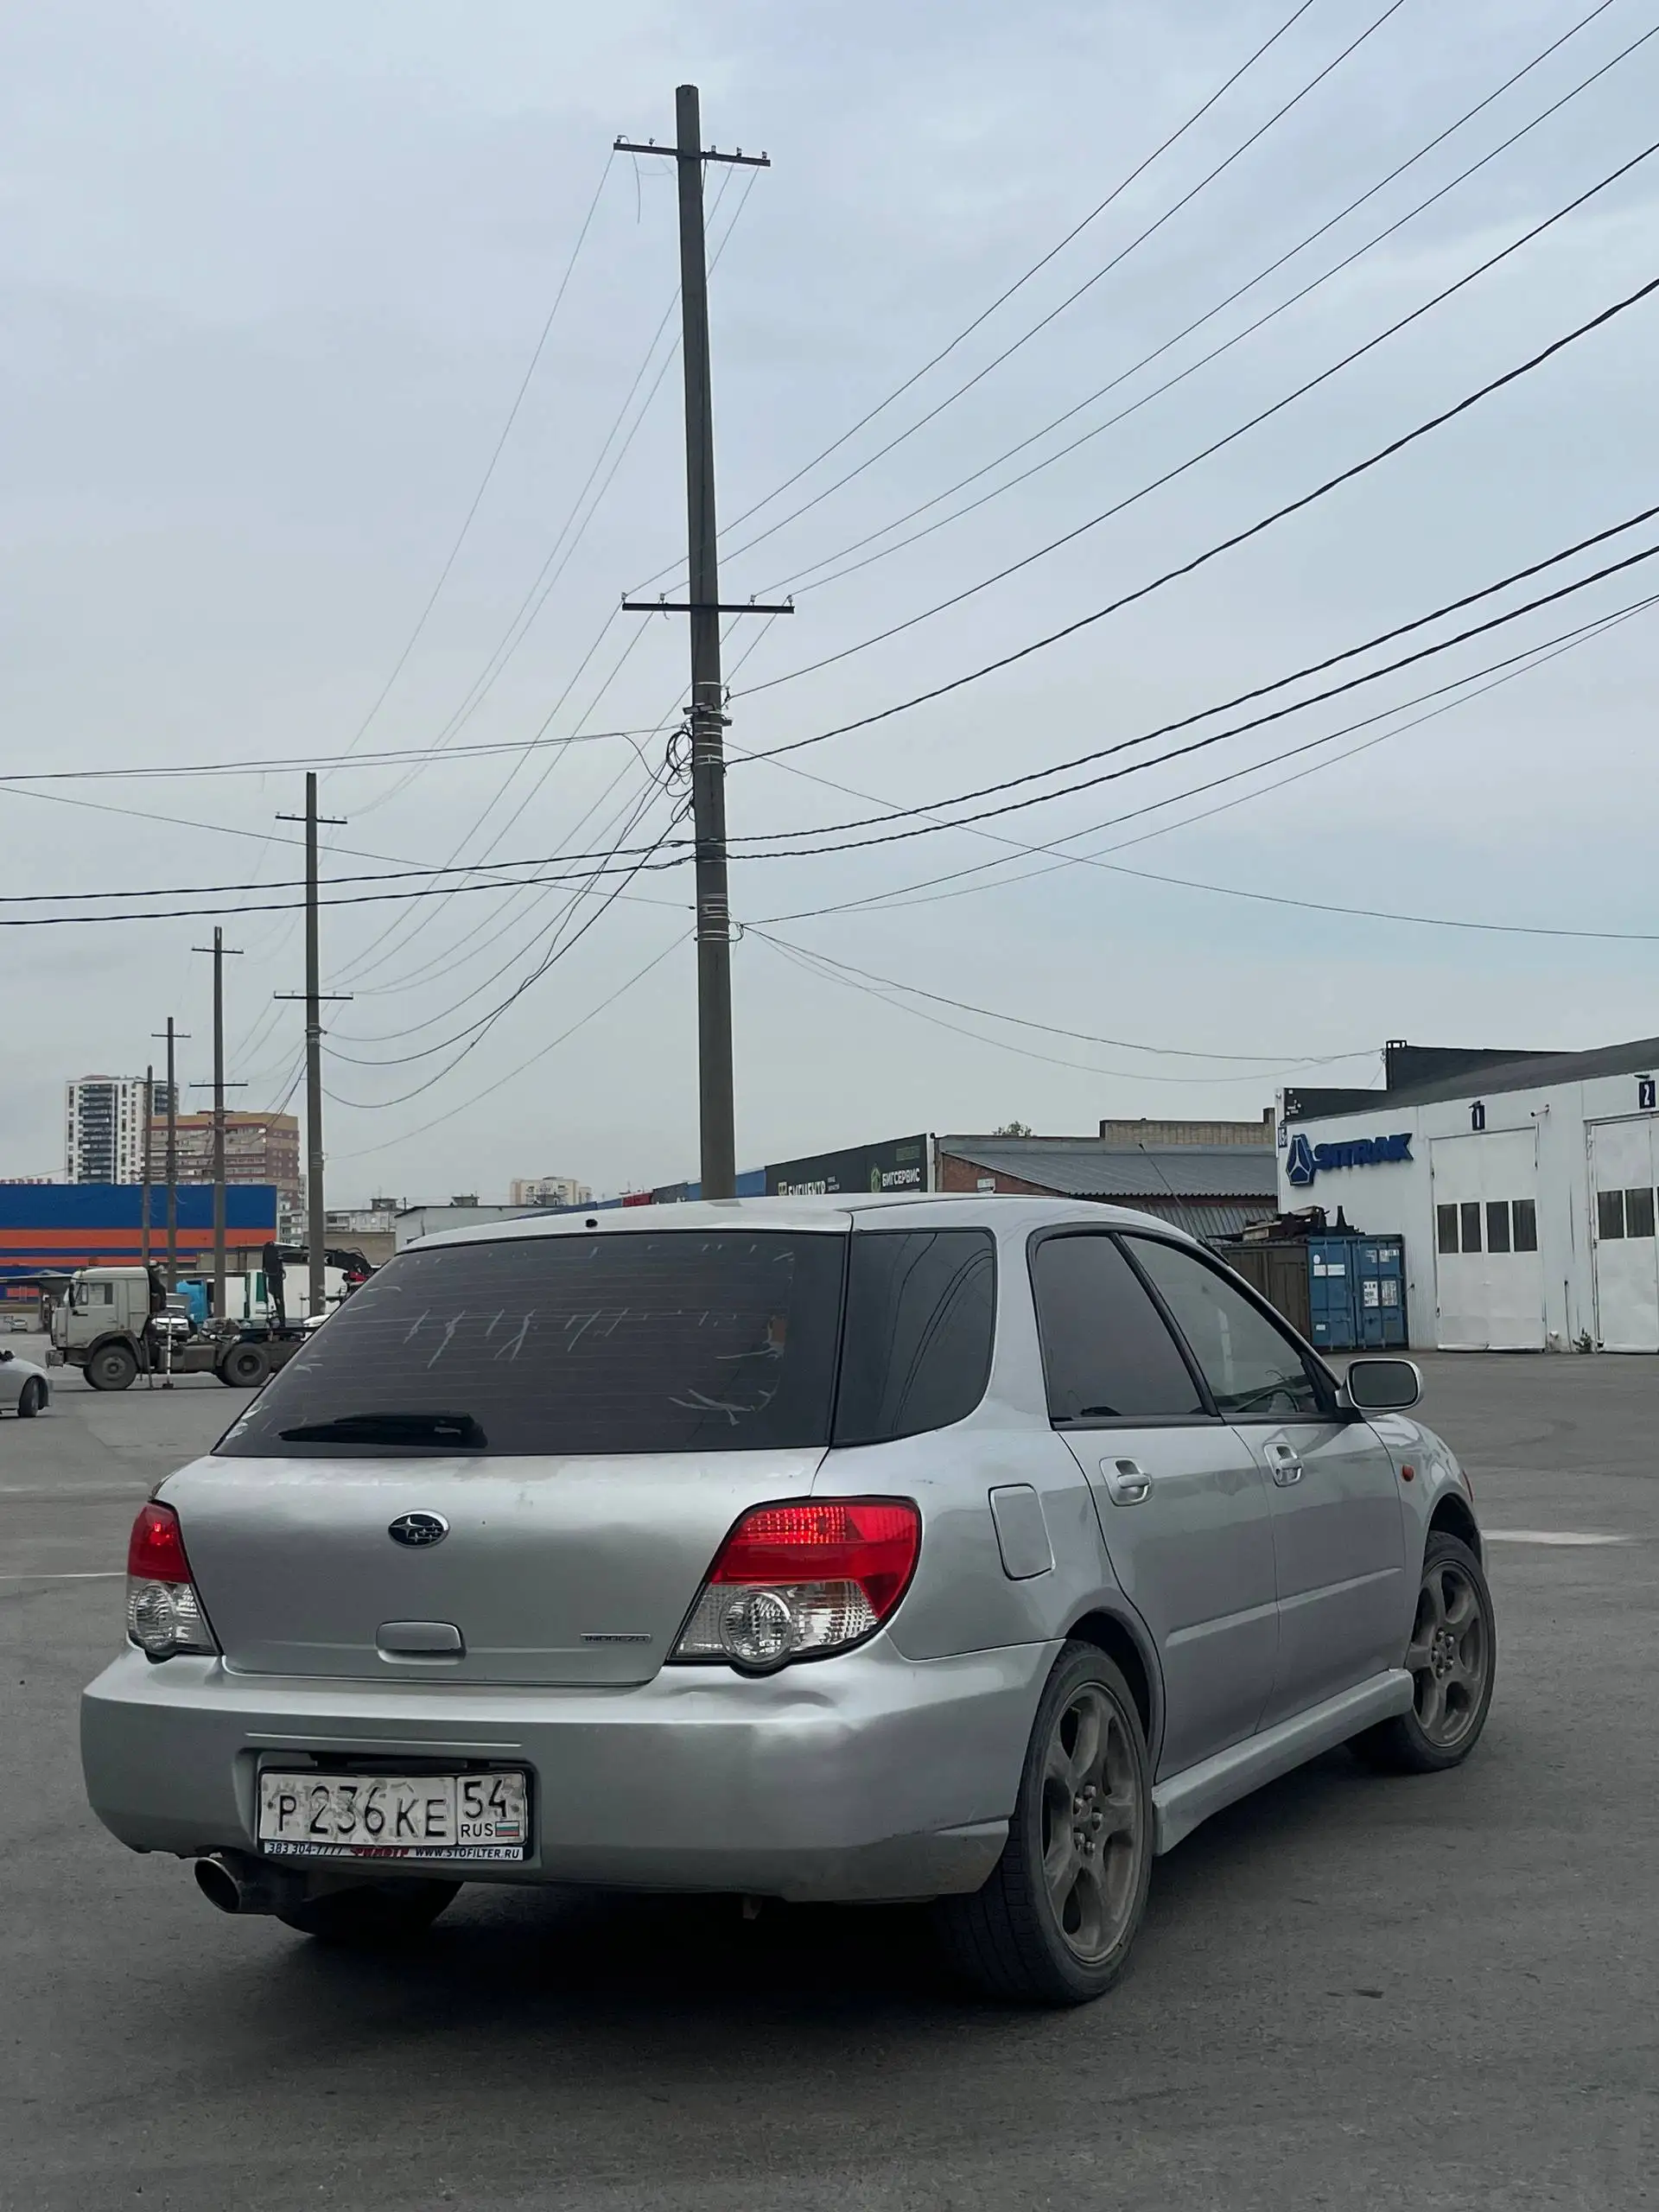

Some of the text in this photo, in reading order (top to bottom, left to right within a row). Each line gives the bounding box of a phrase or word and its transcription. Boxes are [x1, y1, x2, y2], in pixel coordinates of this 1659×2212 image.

[1643, 1084, 1650, 1106] 2
[1313, 1133, 1414, 1169] SITRAK
[463, 1780, 508, 1819] 54
[461, 1823, 493, 1838] RUS
[268, 1842, 289, 1853] 383
